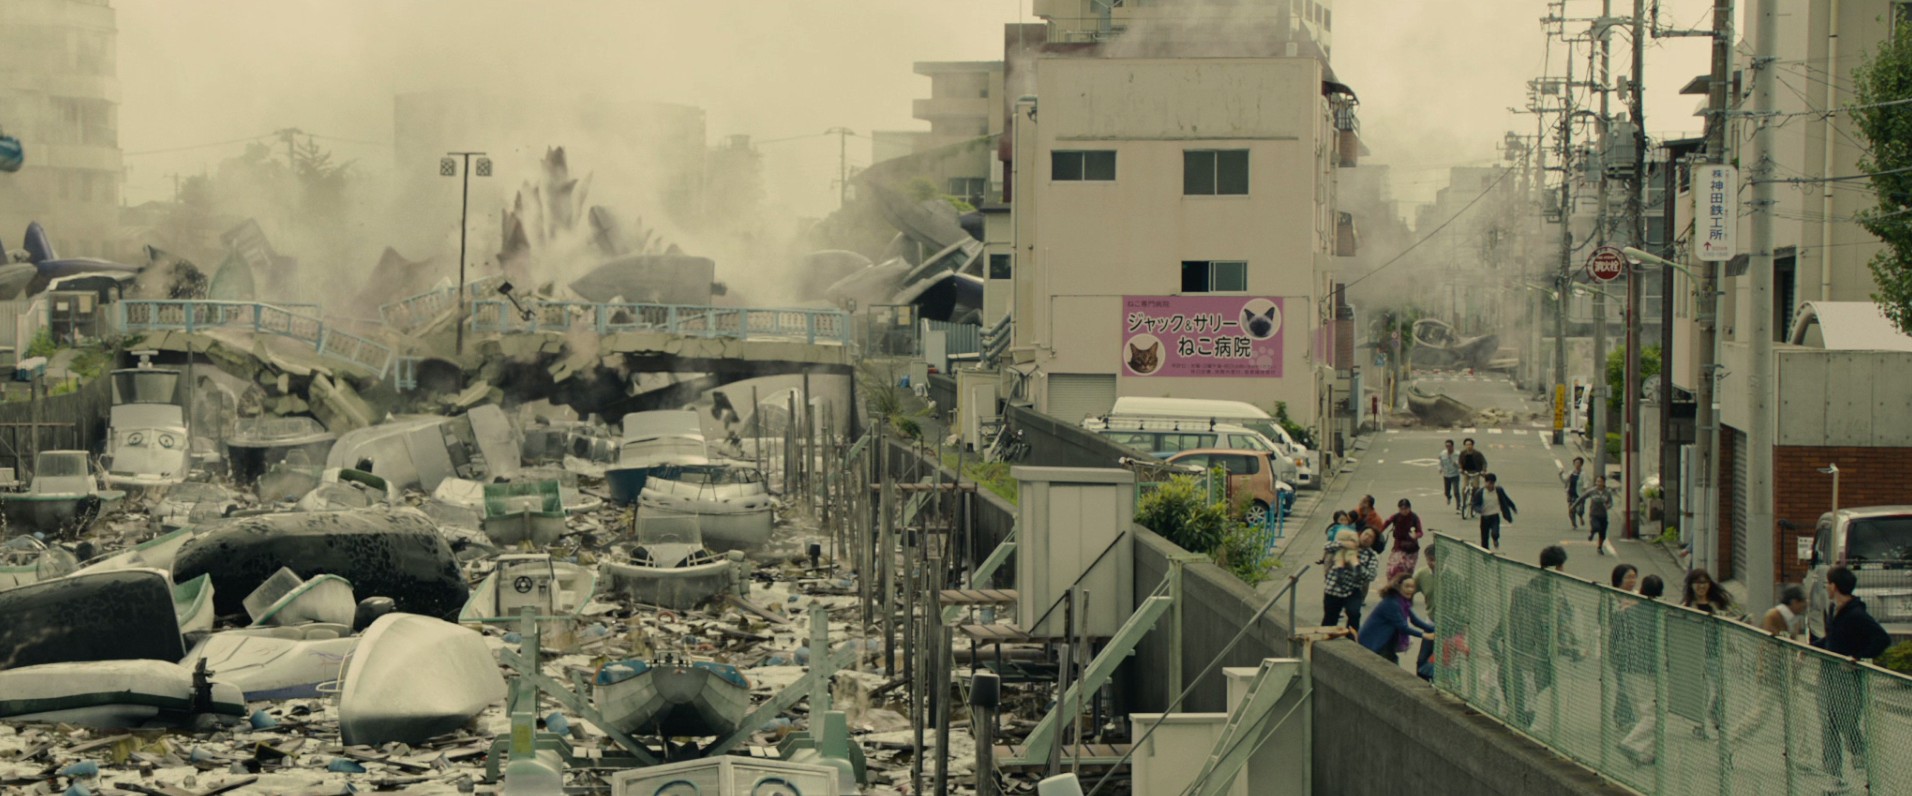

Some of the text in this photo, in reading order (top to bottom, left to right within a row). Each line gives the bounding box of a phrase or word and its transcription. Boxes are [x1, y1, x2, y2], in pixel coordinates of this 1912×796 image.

[1594, 259, 1620, 272] 消火栓
[1128, 313, 1238, 332] ジャック&サリー
[1178, 336, 1251, 357] ねこ病院
